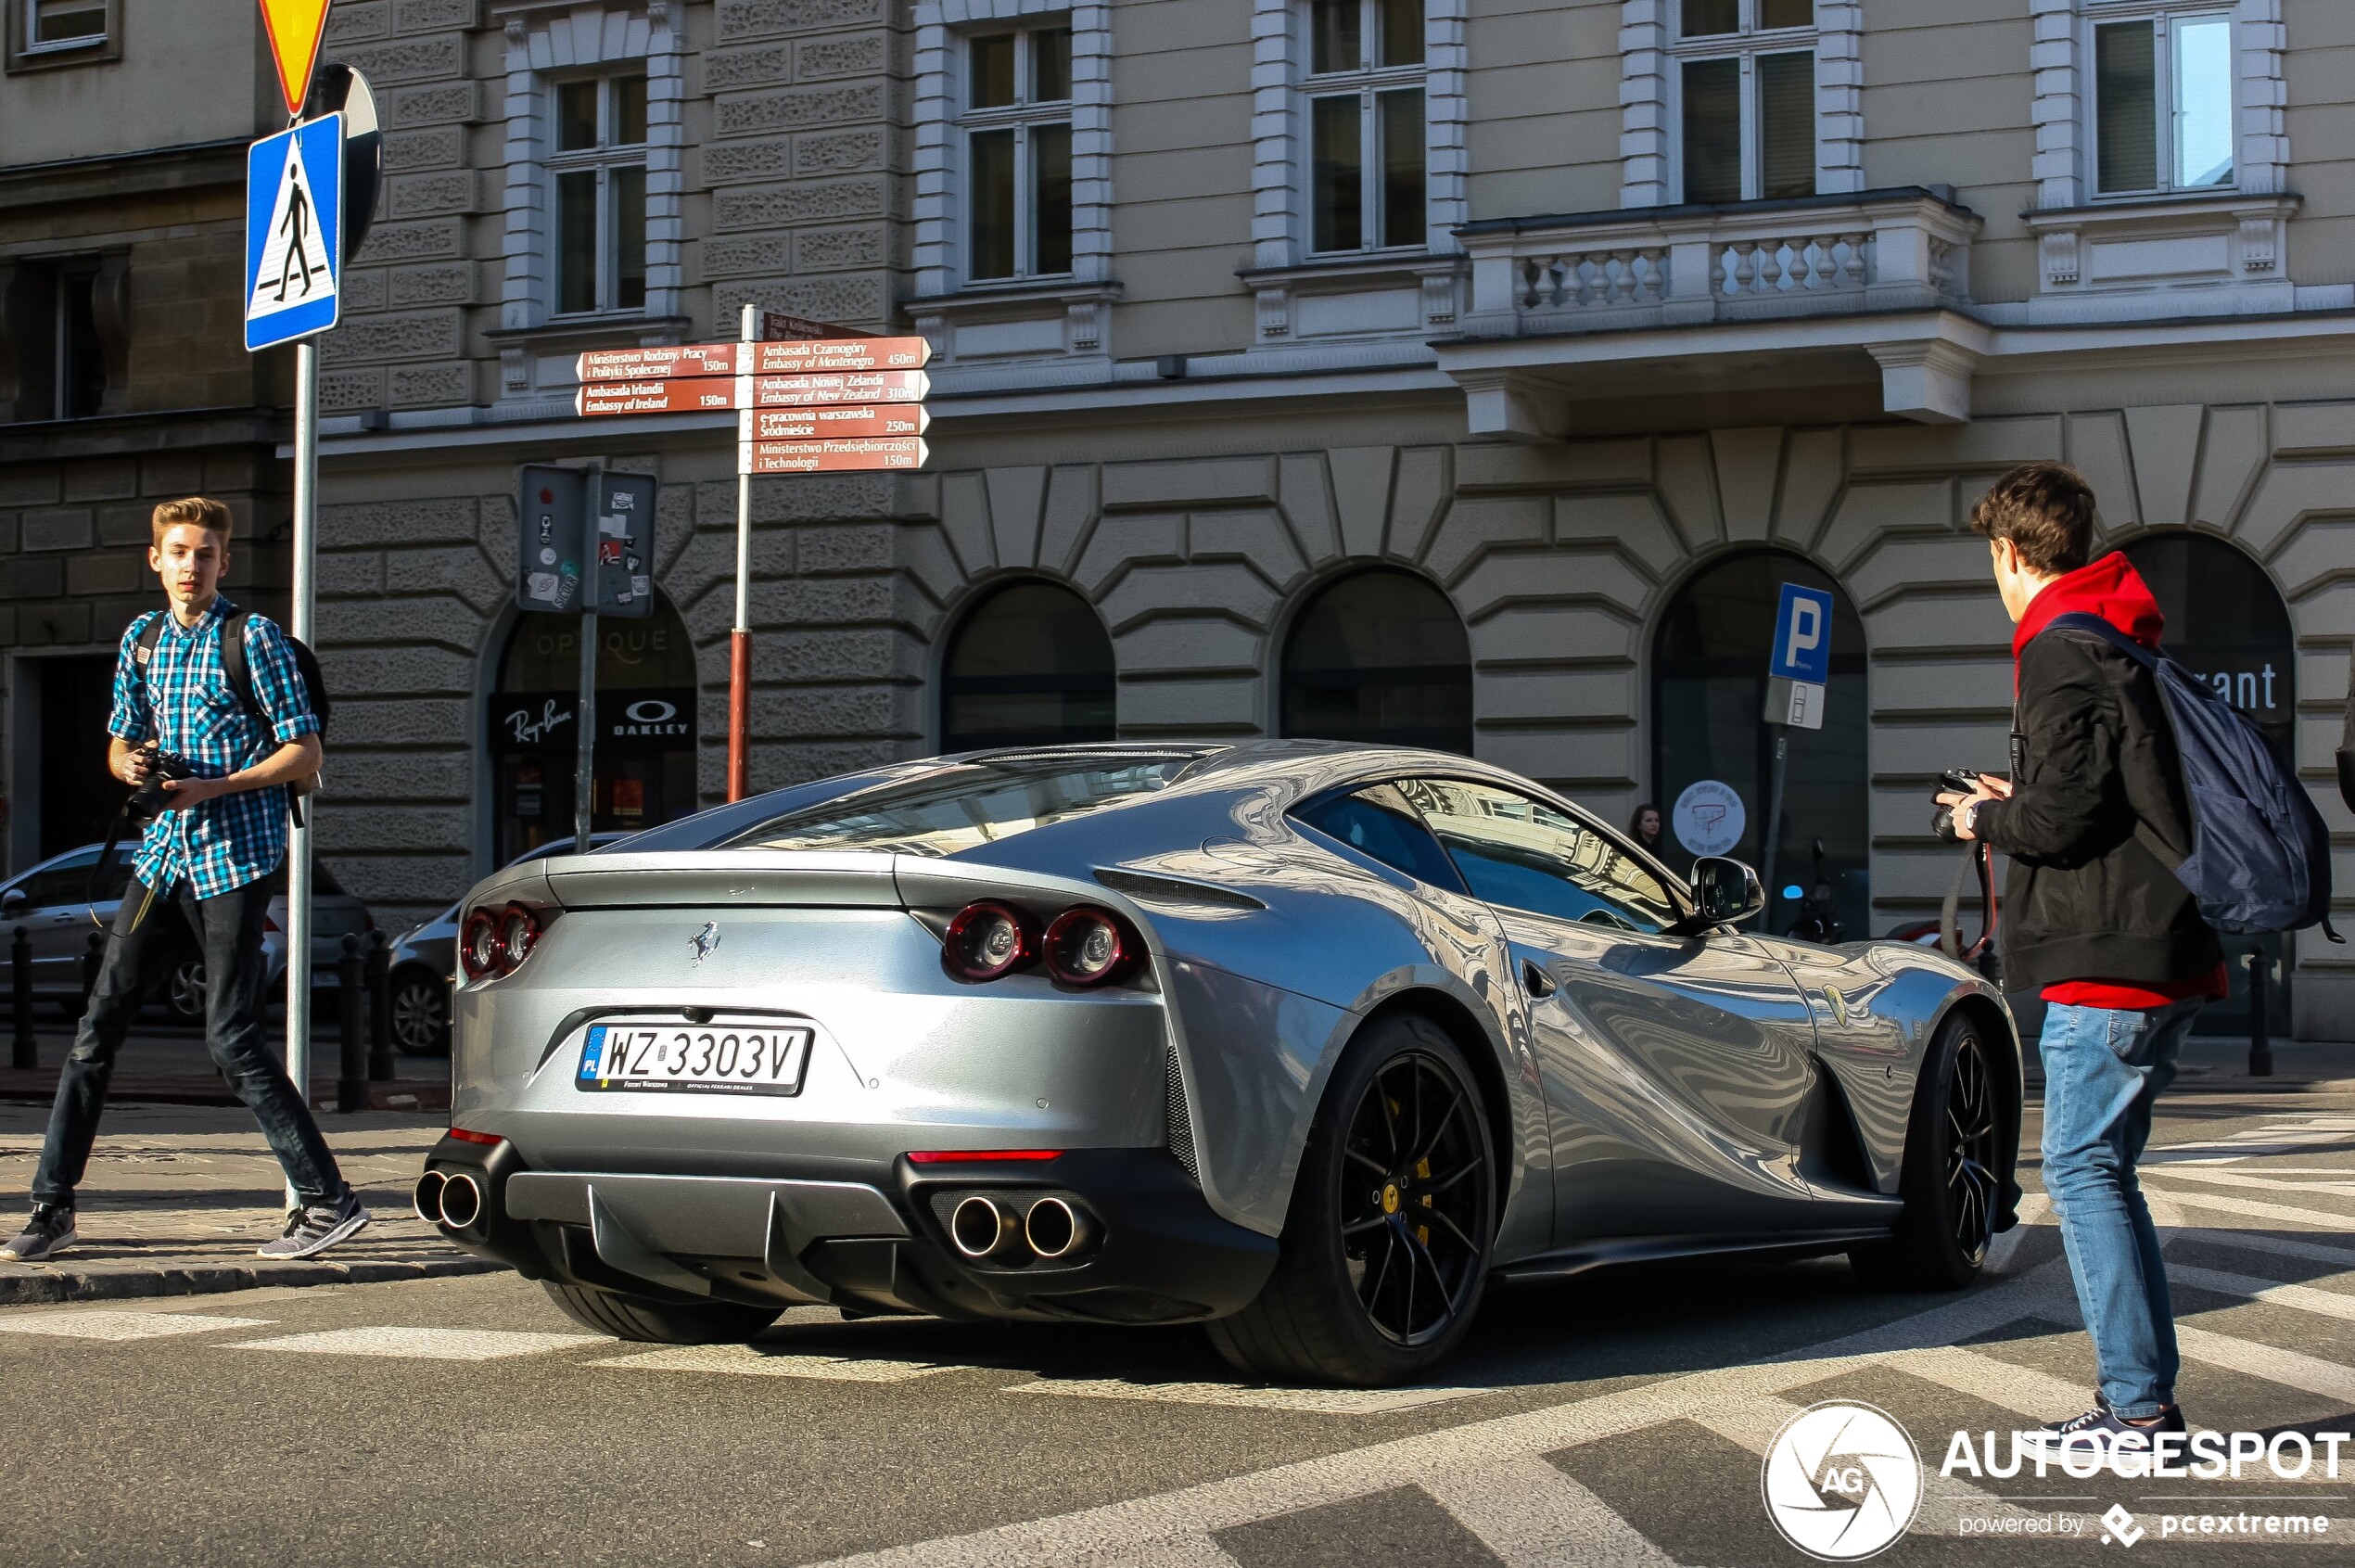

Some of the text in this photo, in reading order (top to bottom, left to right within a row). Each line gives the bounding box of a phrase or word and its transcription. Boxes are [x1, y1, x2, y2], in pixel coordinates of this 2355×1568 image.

[588, 349, 707, 365] Ministerstwo Rodziny, Pracy
[763, 342, 867, 357] Ambasada Czarnogóry
[703, 361, 728, 371] 150m
[762, 356, 875, 370] Embassy of Montenegro
[887, 354, 917, 365] 450m
[586, 368, 591, 378] i
[592, 365, 623, 380] Polityki
[761, 374, 884, 390] Ambasada Nowej Zelandii
[586, 383, 664, 397] Ambasada Irlandii
[761, 388, 881, 405] Embassy of New Zealand
[886, 388, 916, 399] 310m
[586, 397, 668, 414] Embassy of Ireland
[700, 395, 727, 407] 150m
[760, 407, 875, 426] e-pracownia warszawska
[760, 422, 815, 437] Śródmieście
[886, 421, 915, 432] 250m
[759, 440, 916, 455] Ministerstwo Przedsiębiorczości
[759, 456, 819, 471] i Technologii
[884, 455, 912, 466] 150m
[1786, 597, 1821, 667] P
[613, 724, 688, 735] OAKLEY
[607, 1033, 794, 1079] WZ 3303V
[583, 1059, 597, 1071] PL
